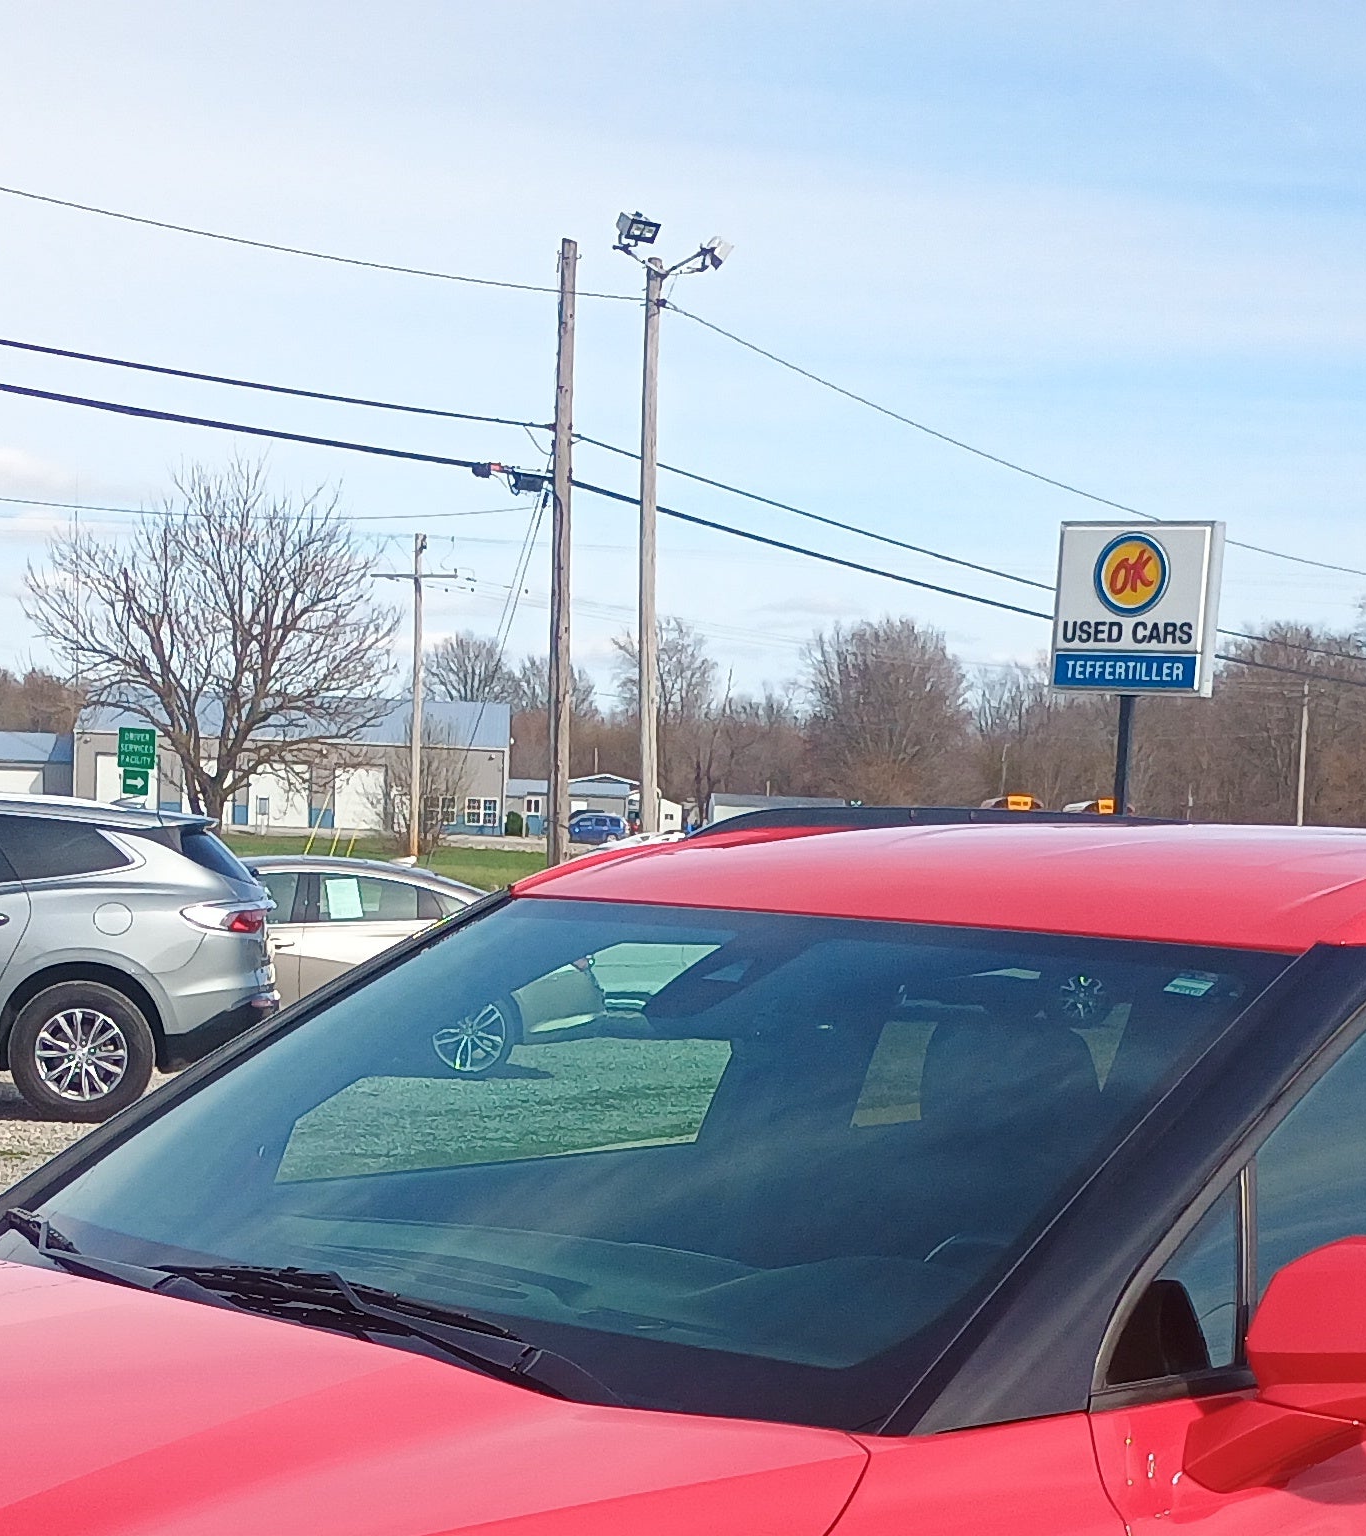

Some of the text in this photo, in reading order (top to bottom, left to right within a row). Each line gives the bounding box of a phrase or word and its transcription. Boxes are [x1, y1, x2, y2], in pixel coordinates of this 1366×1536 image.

[1109, 549, 1155, 596] OK
[1062, 620, 1193, 645] USED CARS
[1066, 660, 1184, 682] TEFFERTILLER
[124, 732, 150, 741] DRIVER
[120, 743, 154, 753] SERVICES
[120, 755, 152, 765] FACILITY
